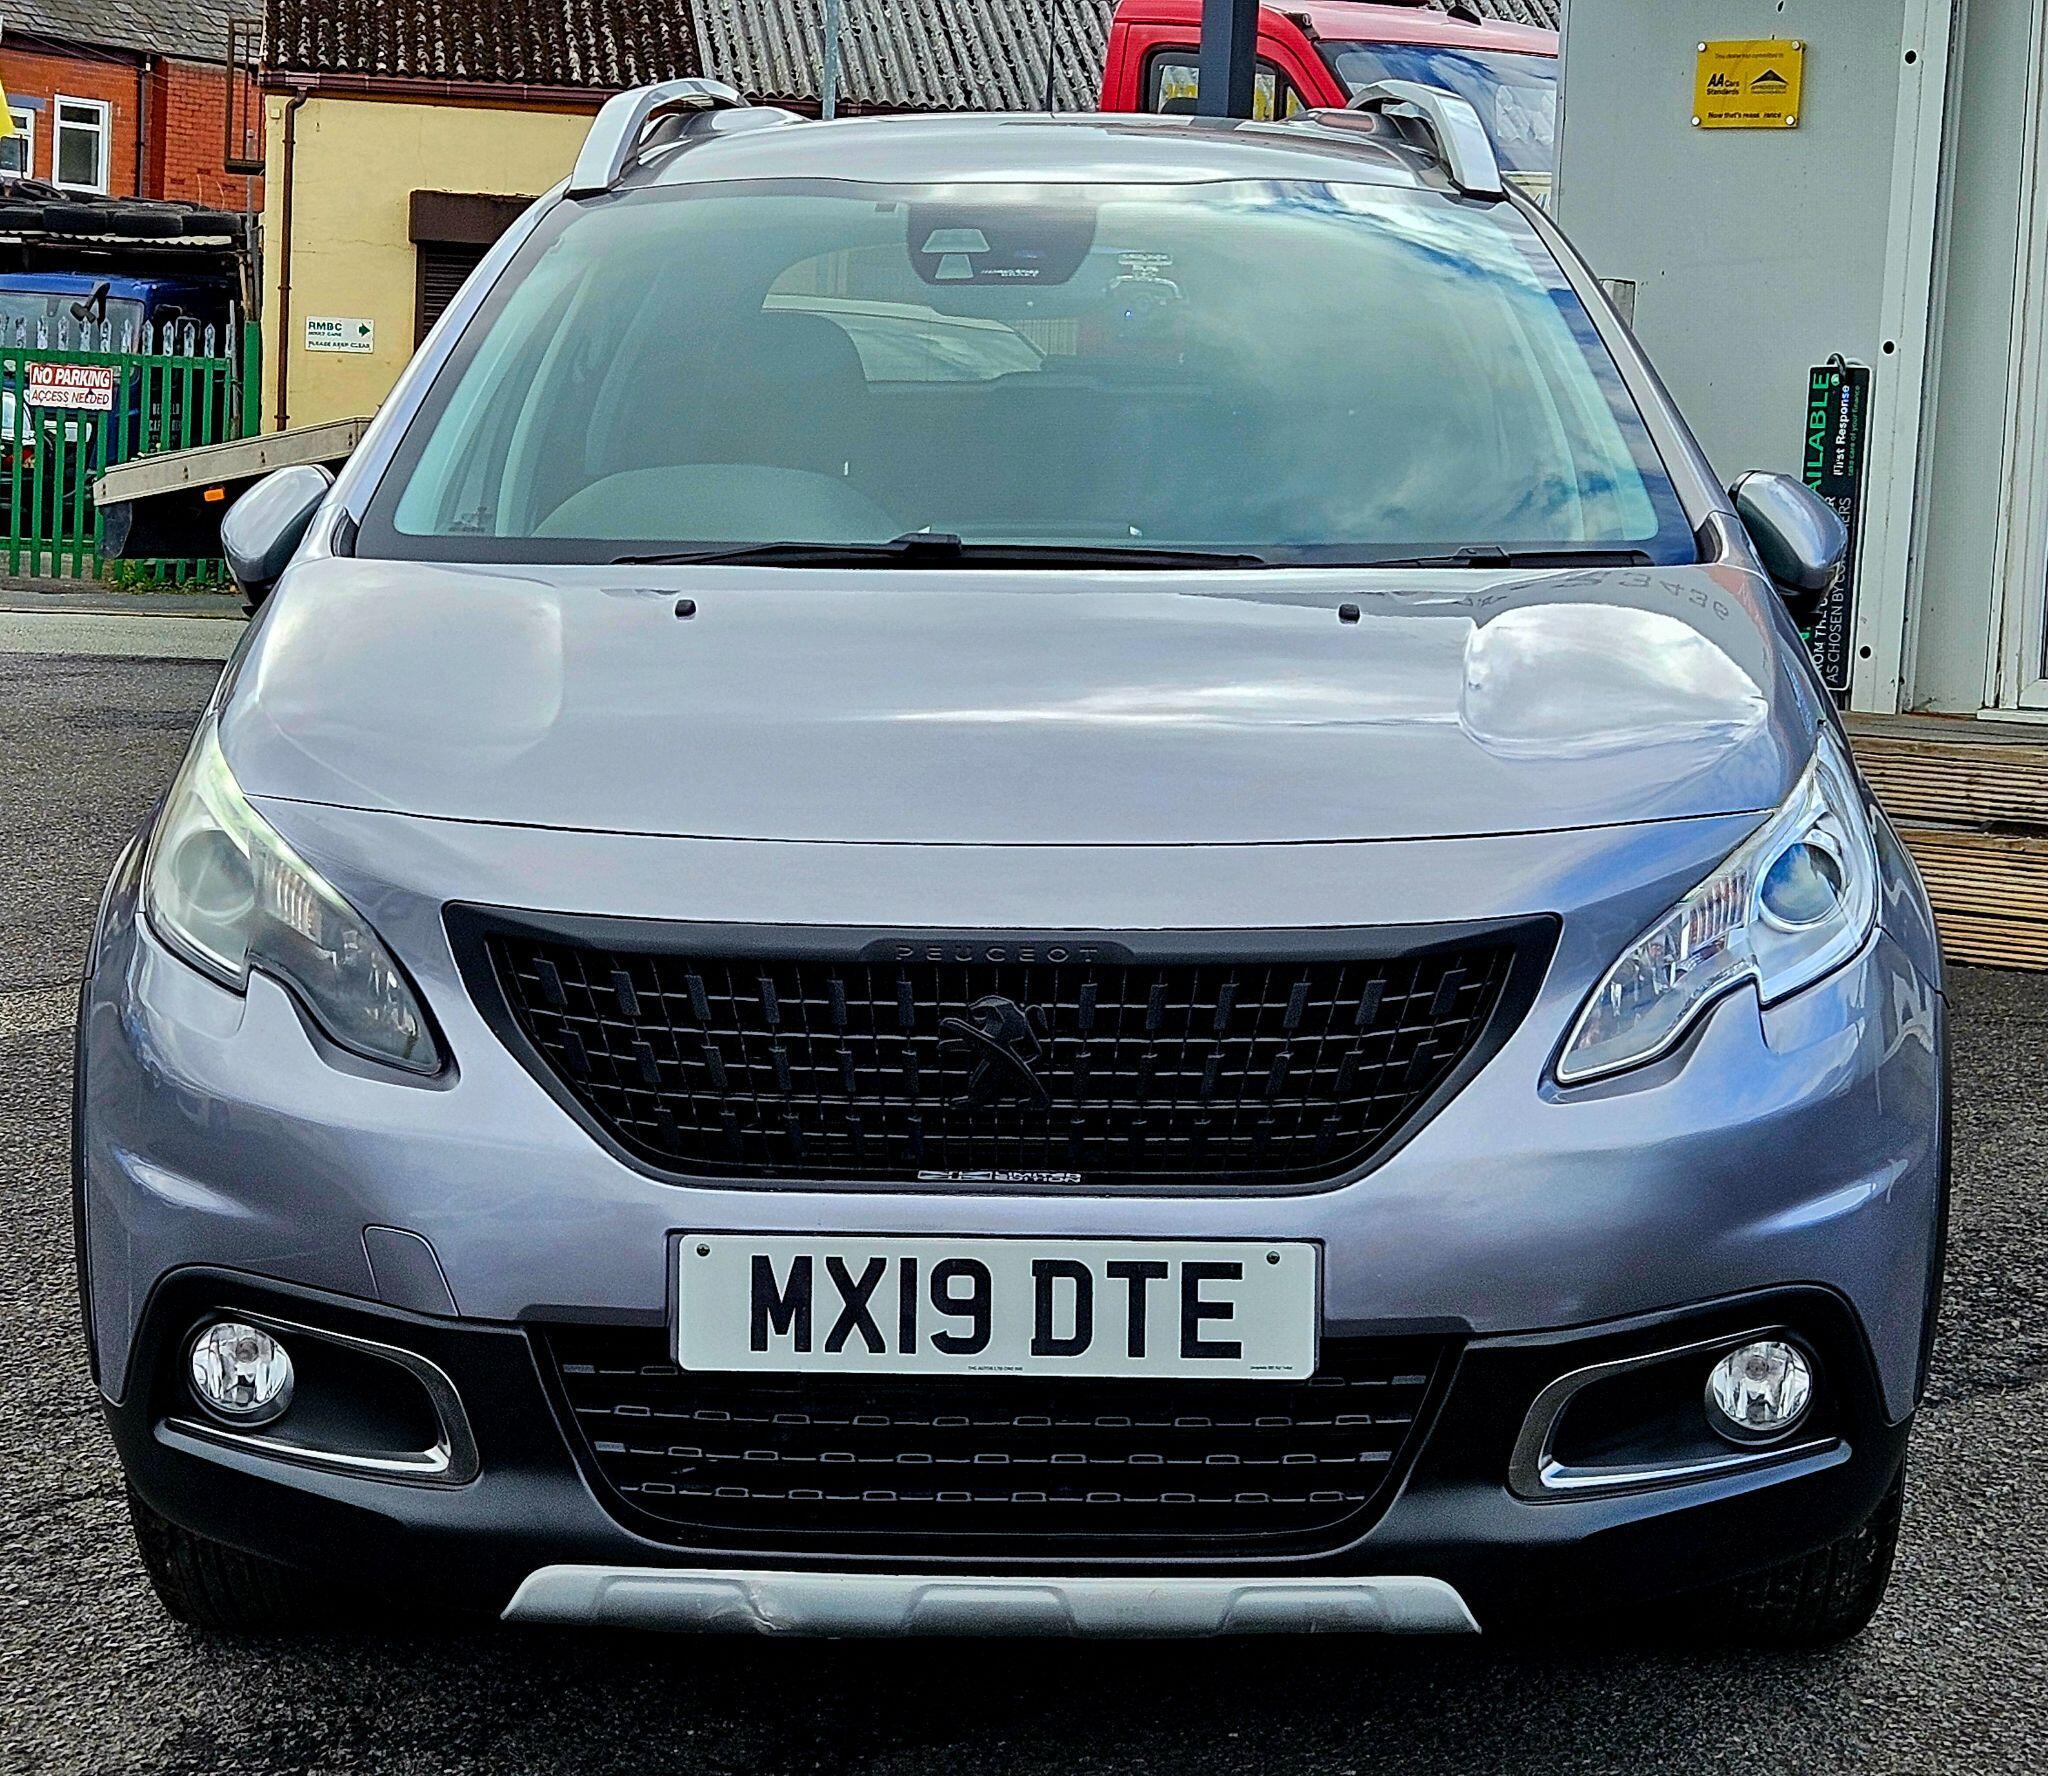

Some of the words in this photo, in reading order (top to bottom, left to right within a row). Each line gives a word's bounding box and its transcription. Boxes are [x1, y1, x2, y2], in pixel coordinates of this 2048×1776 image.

[1707, 73, 1725, 87] AA
[1725, 79, 1740, 87] Cars
[1706, 88, 1740, 96] Standards
[1707, 111, 1723, 119] Now
[308, 321, 343, 331] RMBC
[31, 366, 53, 385] NO
[54, 367, 111, 388] PARKING
[31, 389, 70, 403] ACCESS
[1835, 385, 1850, 446] Response
[1831, 585, 1844, 602] BY
[1827, 605, 1843, 663] CHOSEN
[1826, 664, 1839, 684] AS
[894, 945, 1099, 962] PEUGEOT
[749, 1254, 993, 1356] MX19
[1029, 1258, 1244, 1360] DTE
